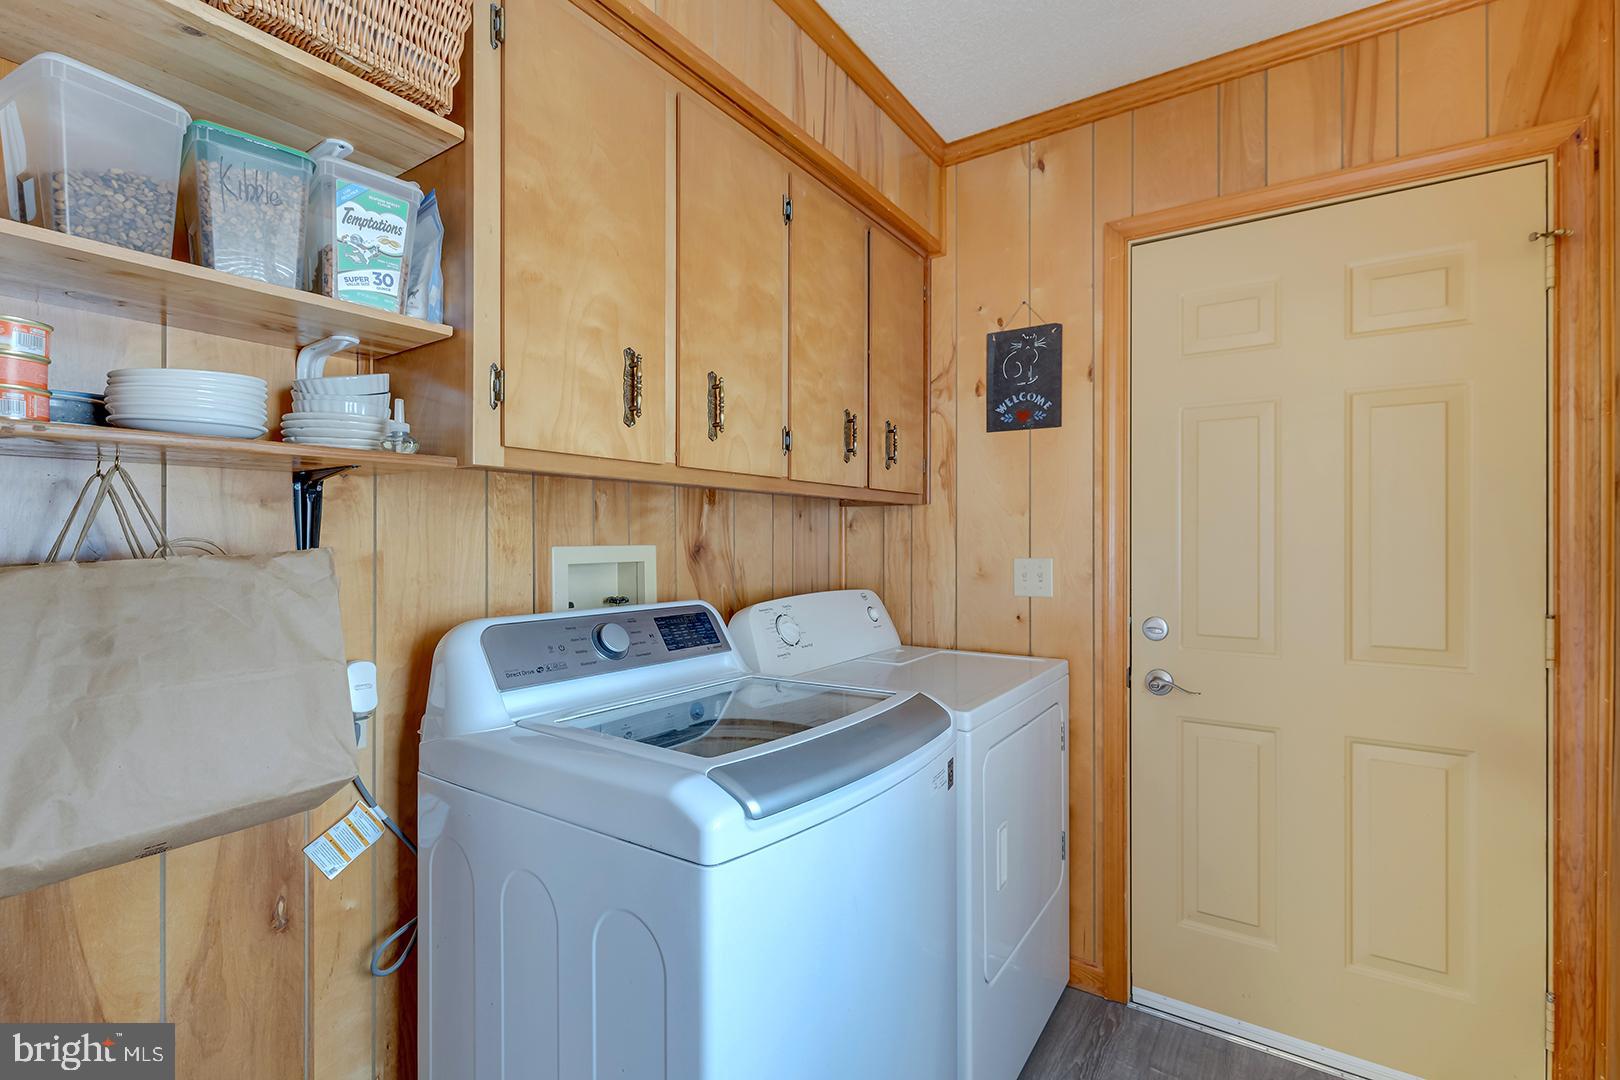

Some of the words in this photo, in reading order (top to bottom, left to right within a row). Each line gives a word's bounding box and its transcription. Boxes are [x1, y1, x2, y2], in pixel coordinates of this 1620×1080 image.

[219, 155, 283, 213] Kibble
[341, 207, 403, 236] Temptations
[372, 271, 394, 288] 30
[995, 392, 1053, 414] WELCOME
[505, 671, 521, 679] Direct
[521, 669, 535, 677] Drive
